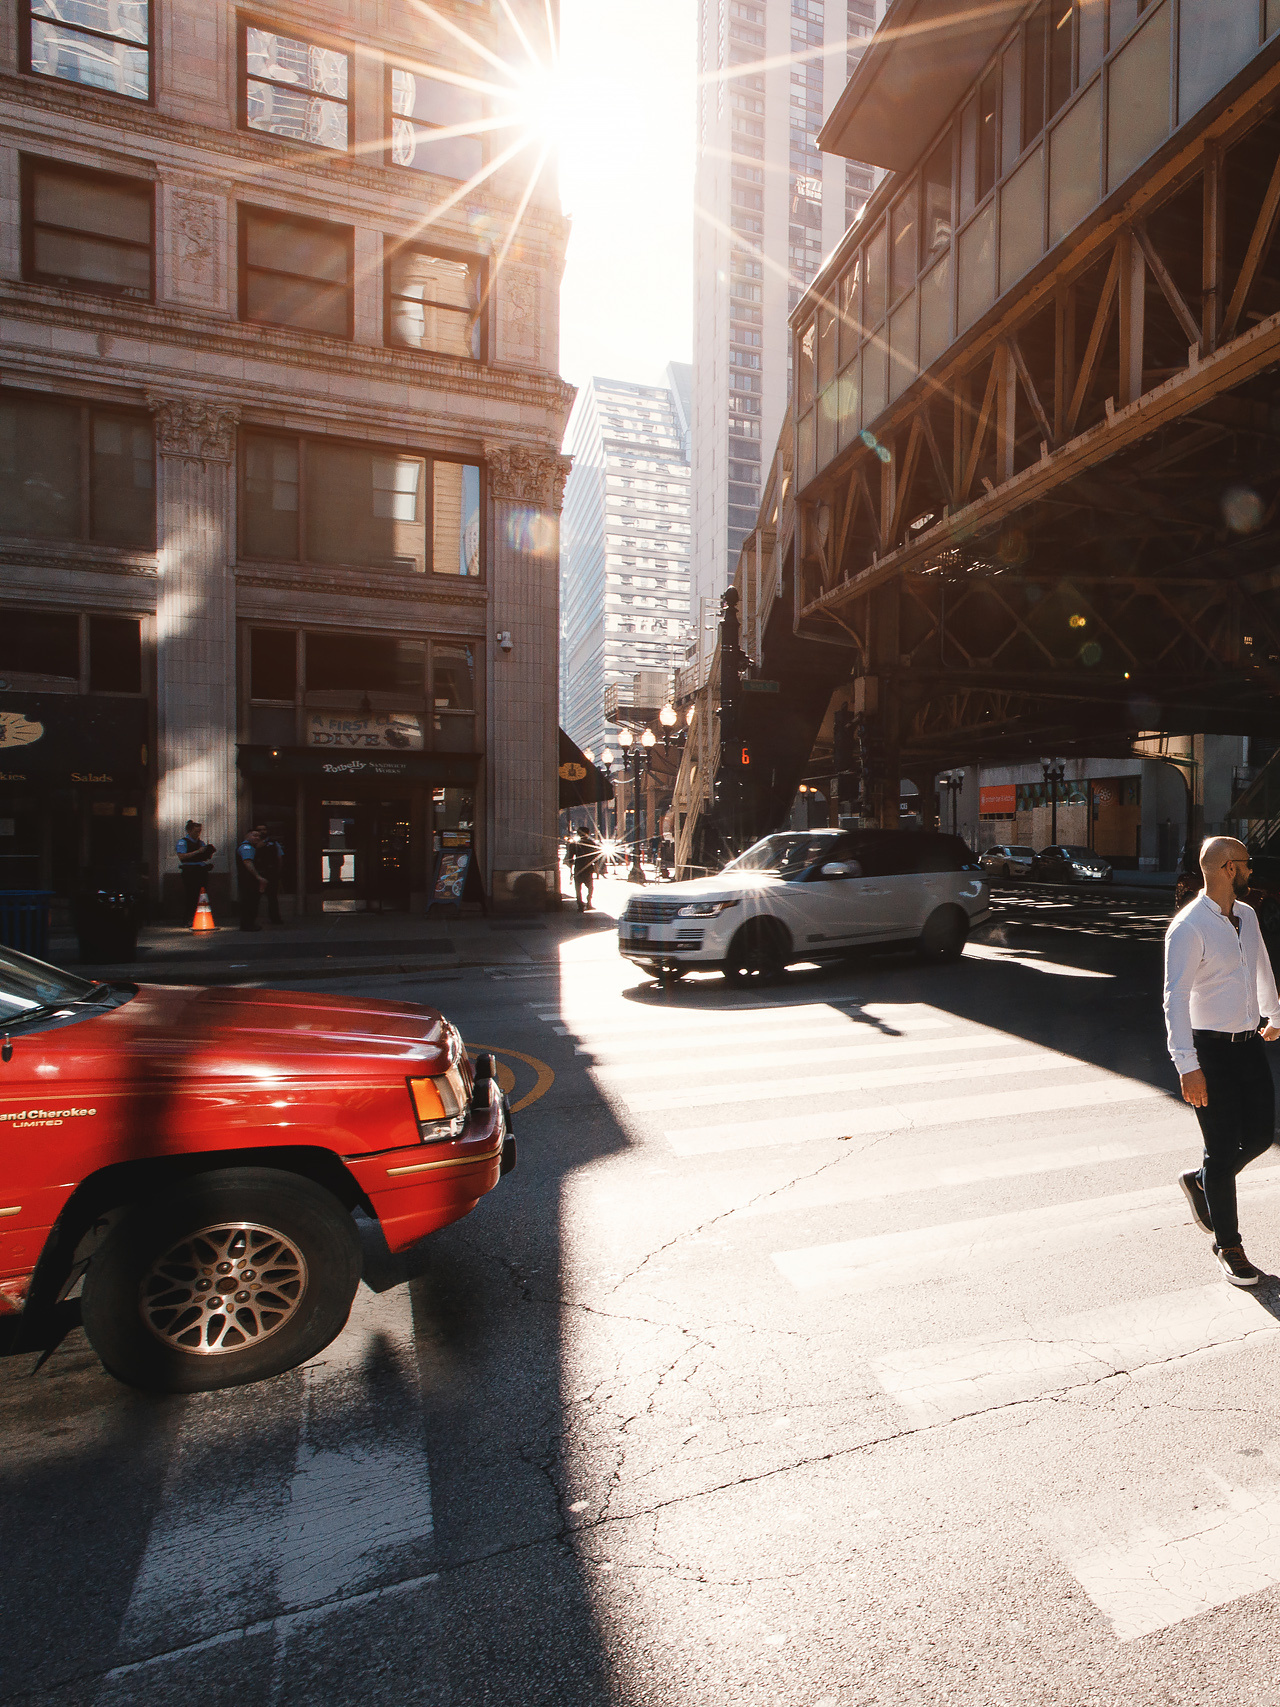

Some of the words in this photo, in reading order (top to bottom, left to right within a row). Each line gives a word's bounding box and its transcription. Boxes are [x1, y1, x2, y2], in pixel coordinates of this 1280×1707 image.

[329, 719, 369, 731] FIRST
[311, 732, 381, 746] DIVE
[742, 748, 750, 764] 6
[322, 760, 367, 773] Potbelly
[70, 772, 114, 782] Salads
[28, 1108, 97, 1119] Cherokee
[12, 1119, 63, 1128] LIMITED
